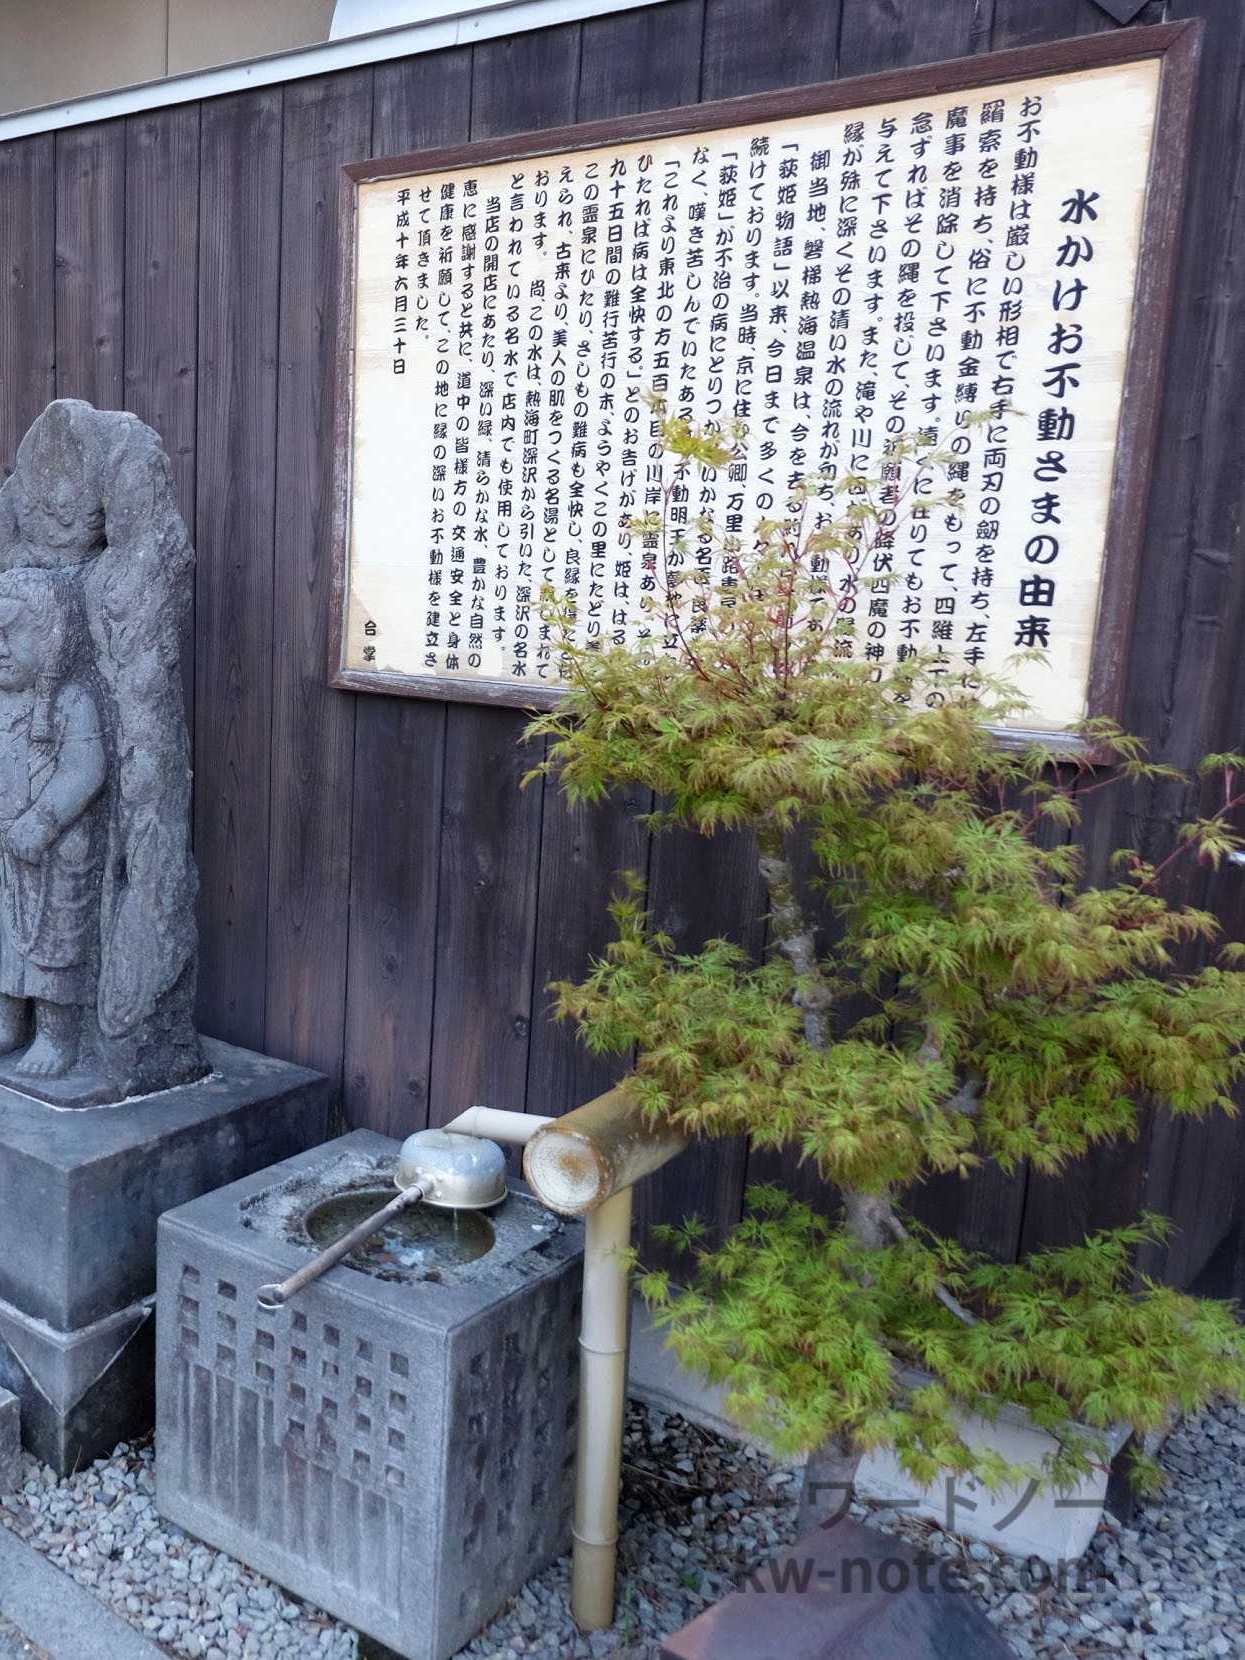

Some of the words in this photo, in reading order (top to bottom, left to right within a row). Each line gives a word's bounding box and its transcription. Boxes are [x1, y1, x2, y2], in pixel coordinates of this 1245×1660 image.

[392, 188, 411, 375] 平成十年六月三十日
[414, 186, 432, 340] せて頂きました。
[1013, 186, 1101, 647] 水かけお不動さまの由来
